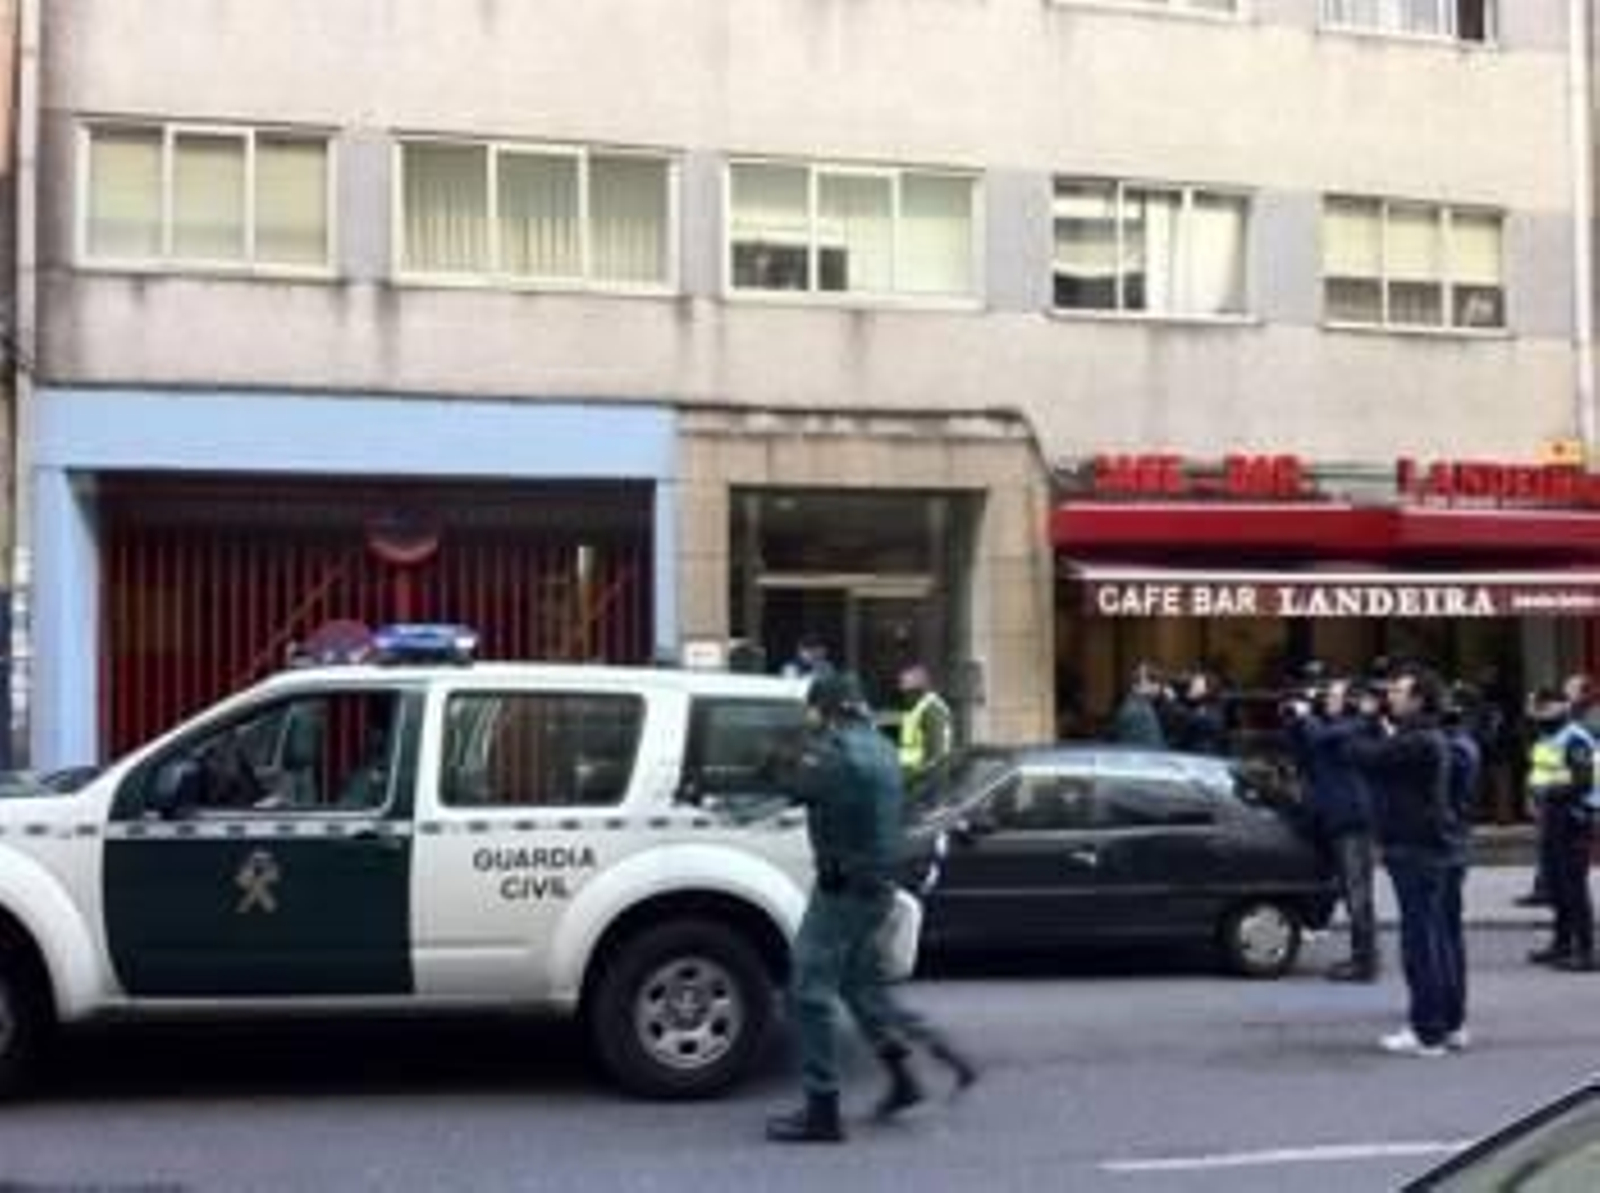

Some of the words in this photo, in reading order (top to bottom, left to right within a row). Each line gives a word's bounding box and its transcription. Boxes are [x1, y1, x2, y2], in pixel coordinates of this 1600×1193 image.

[1099, 585, 1178, 616] CAFE
[1193, 587, 1257, 616] BAR
[1277, 586, 1495, 616] LANDEIRA
[473, 848, 595, 871] GUARDIA
